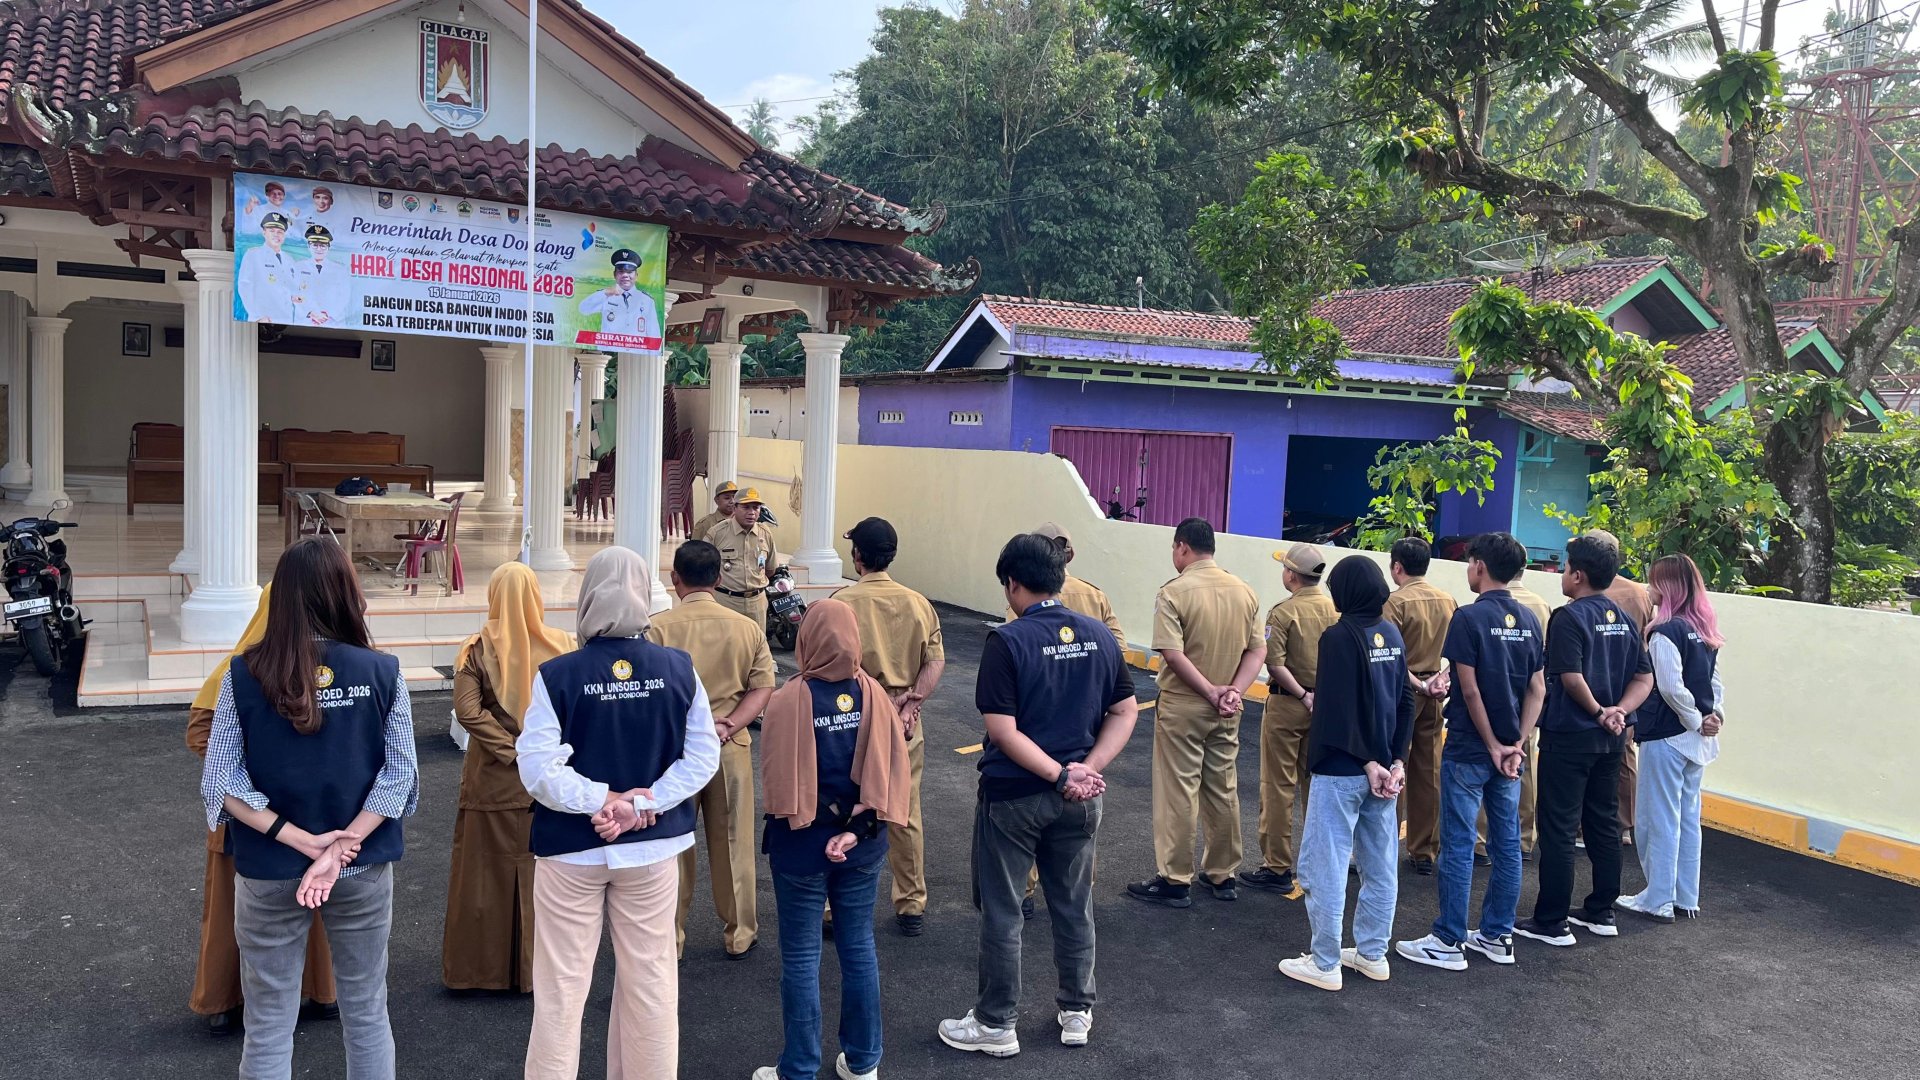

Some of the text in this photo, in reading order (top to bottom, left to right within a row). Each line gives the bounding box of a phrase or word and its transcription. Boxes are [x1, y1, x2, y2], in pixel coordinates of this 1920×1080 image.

[423, 22, 487, 41] CILACAP
[350, 216, 453, 242] Pemerintah
[458, 228, 497, 248] Desa
[361, 240, 439, 260] Mengucapkan
[440, 247, 487, 263] Selamat
[350, 253, 575, 297] HARI DESA NASIONAL 2026
[428, 286, 501, 304] 15 Januari 2026
[363, 295, 413, 311] BANGUN
[415, 299, 444, 314] DESA
[446, 302, 492, 319] BANGUN
[362, 312, 393, 328] DESA
[395, 315, 453, 332] TERDEPAN
[455, 320, 493, 336] UNTUK
[595, 332, 645, 344] SURATMAN
[1042, 641, 1098, 656] KKN UNSOED 2026
[315, 685, 371, 701] SOED 2026
[583, 678, 665, 695] KKN UNSOED 2026
[317, 698, 354, 709] DONDONG
[600, 691, 650, 701] DESA DONDONG
[814, 712, 860, 727] KKN UNSOED
